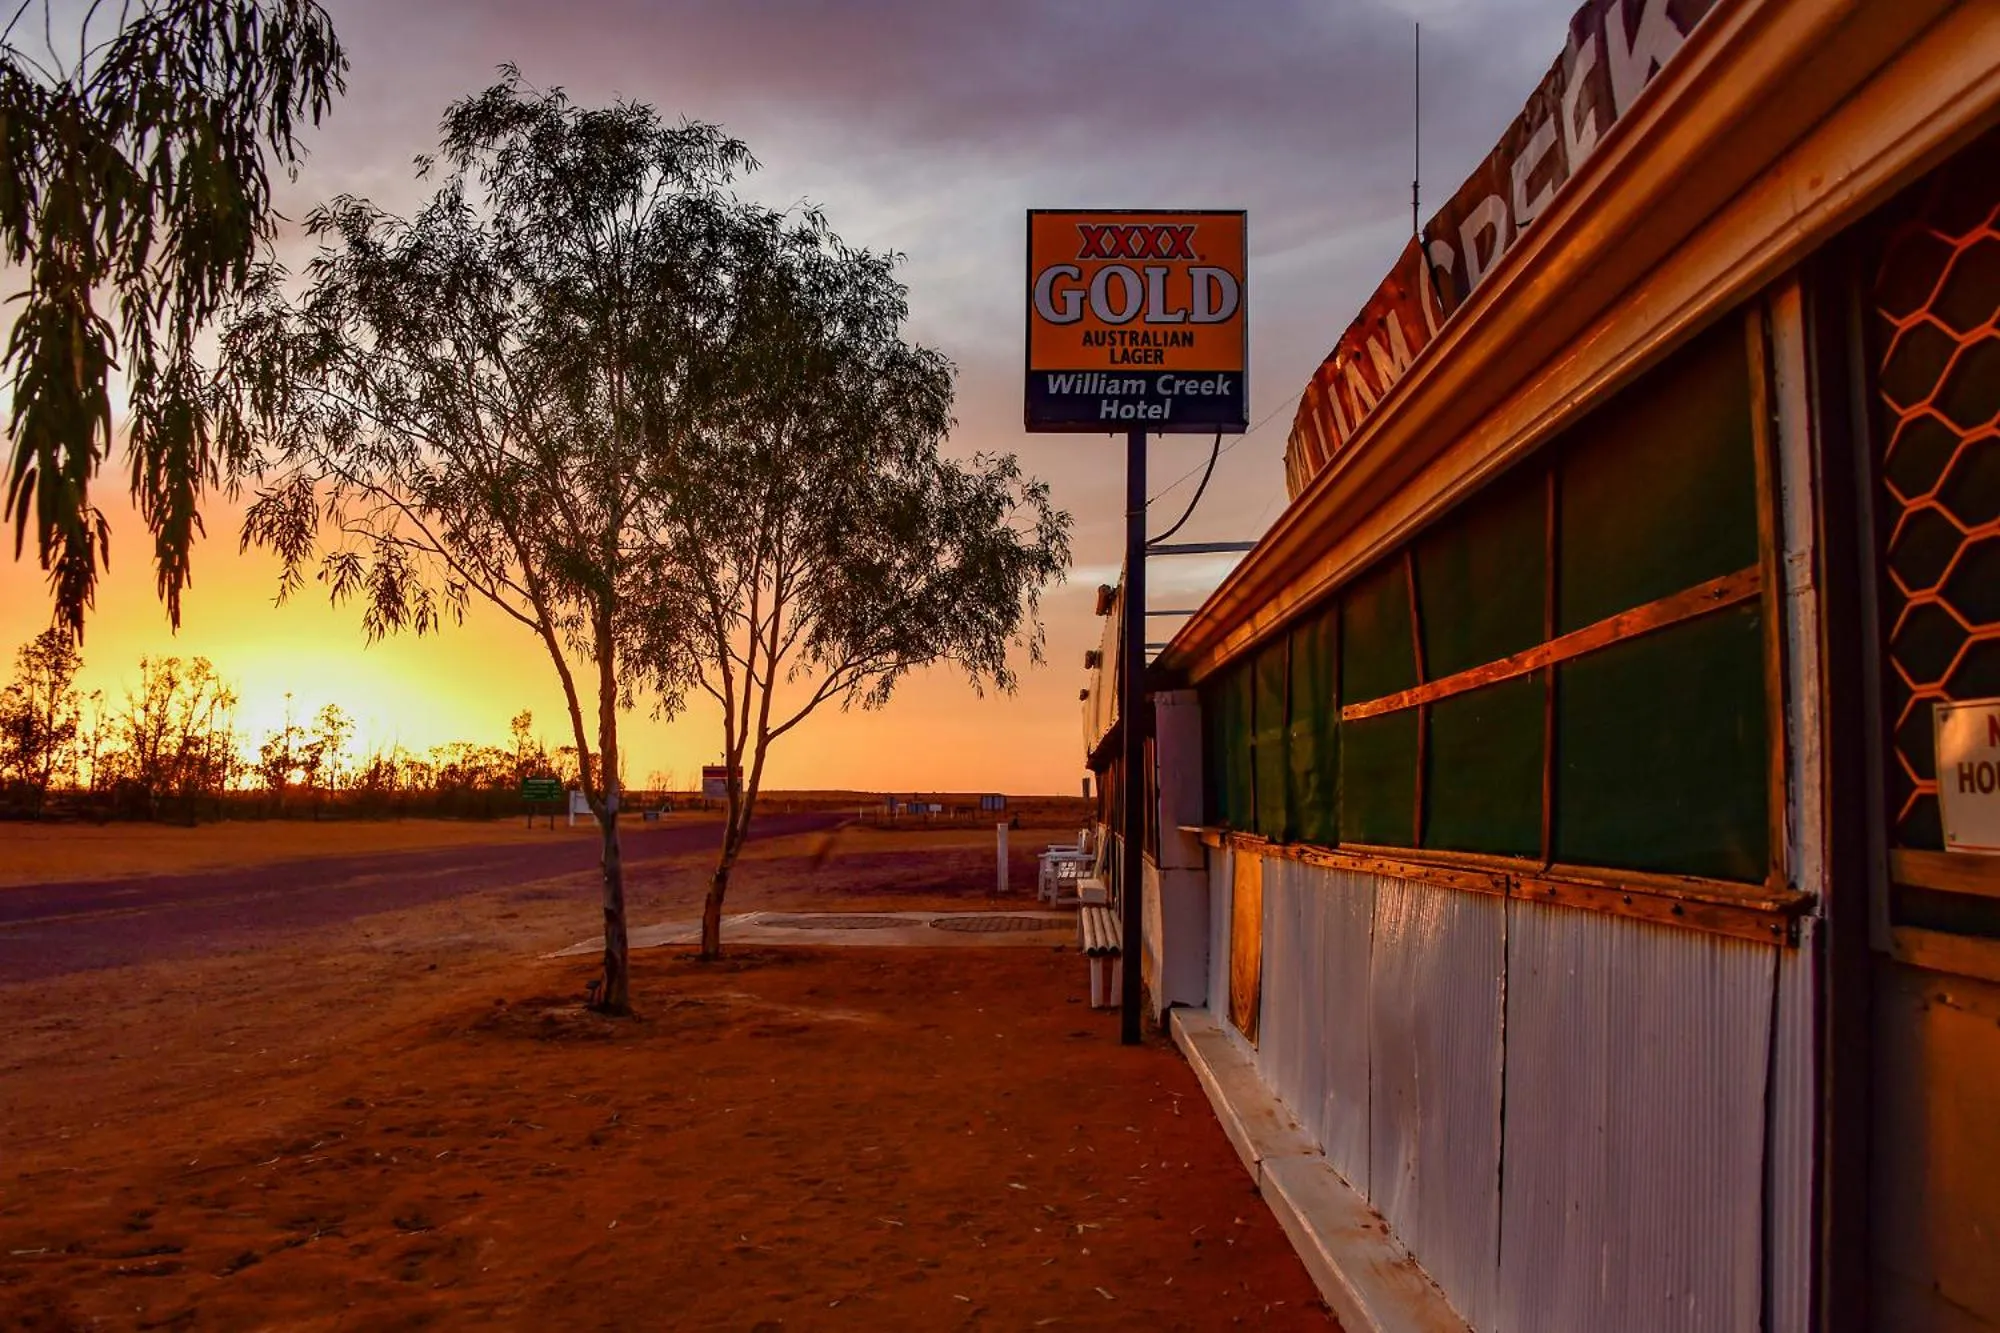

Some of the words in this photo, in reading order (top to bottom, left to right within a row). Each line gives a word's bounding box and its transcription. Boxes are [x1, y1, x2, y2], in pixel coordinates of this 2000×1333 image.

[1076, 224, 1199, 261] XXXX
[1033, 264, 1241, 325] GOLD
[1082, 331, 1194, 347] AUSTRALIAN
[1110, 349, 1164, 365] LAGER
[1047, 374, 1146, 396] William
[1156, 374, 1233, 396] Creek
[1099, 398, 1172, 420] Hotel
[1957, 761, 2000, 793] HO
